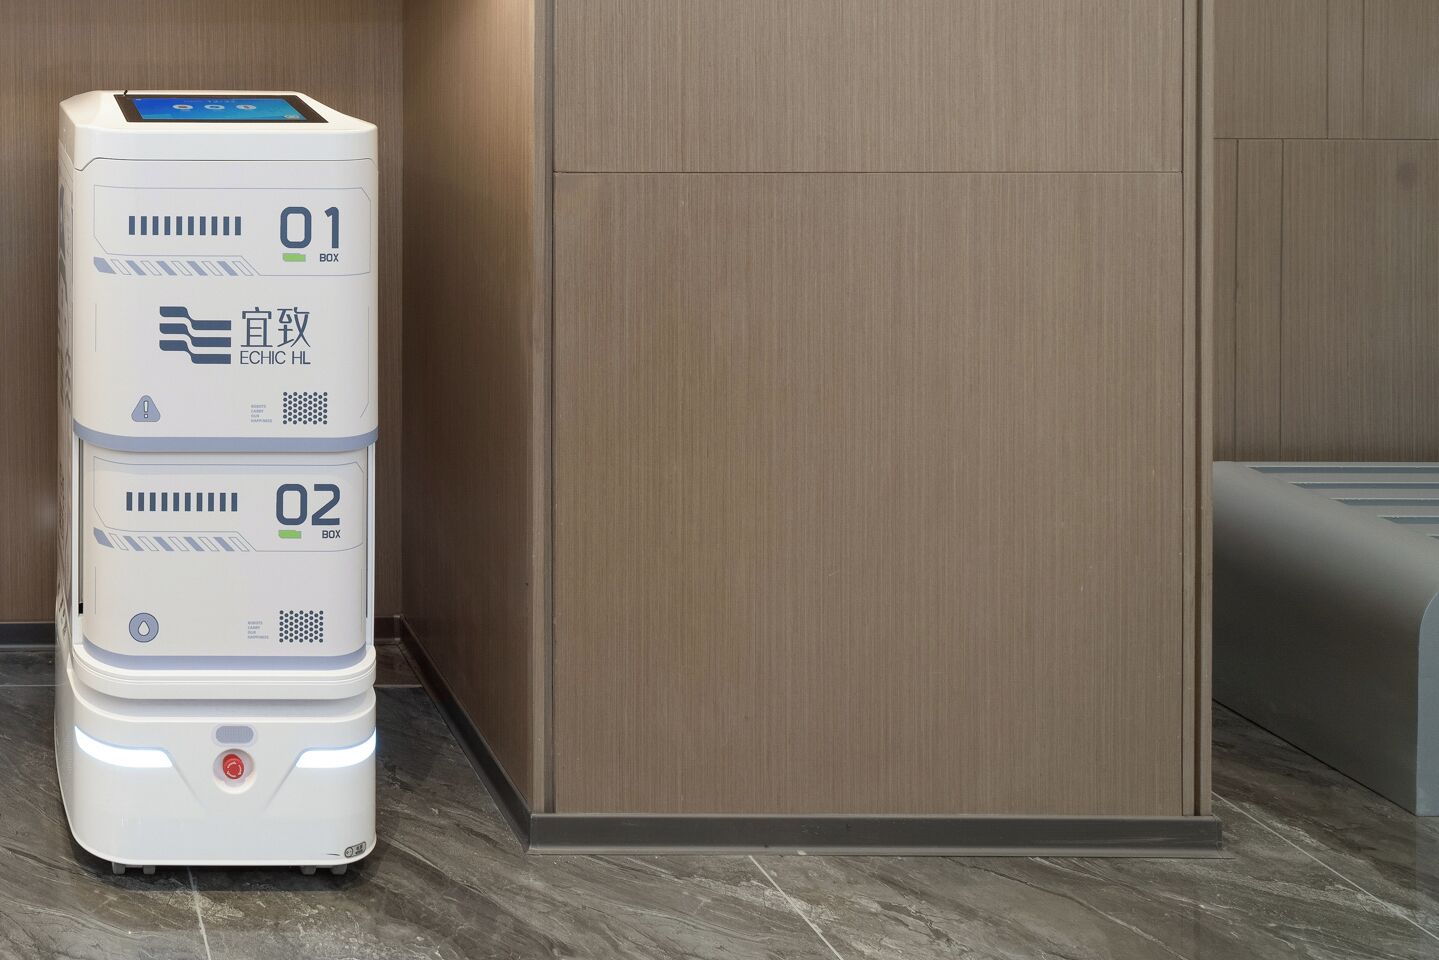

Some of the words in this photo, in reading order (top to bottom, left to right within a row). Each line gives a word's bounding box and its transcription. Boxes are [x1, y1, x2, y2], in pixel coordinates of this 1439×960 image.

[279, 206, 340, 249] 01
[319, 253, 339, 263] BOX
[240, 306, 311, 348] 宜致
[239, 350, 286, 365] ECHIC
[291, 350, 312, 365] HL
[275, 483, 341, 526] 02
[321, 529, 341, 539] BOX
